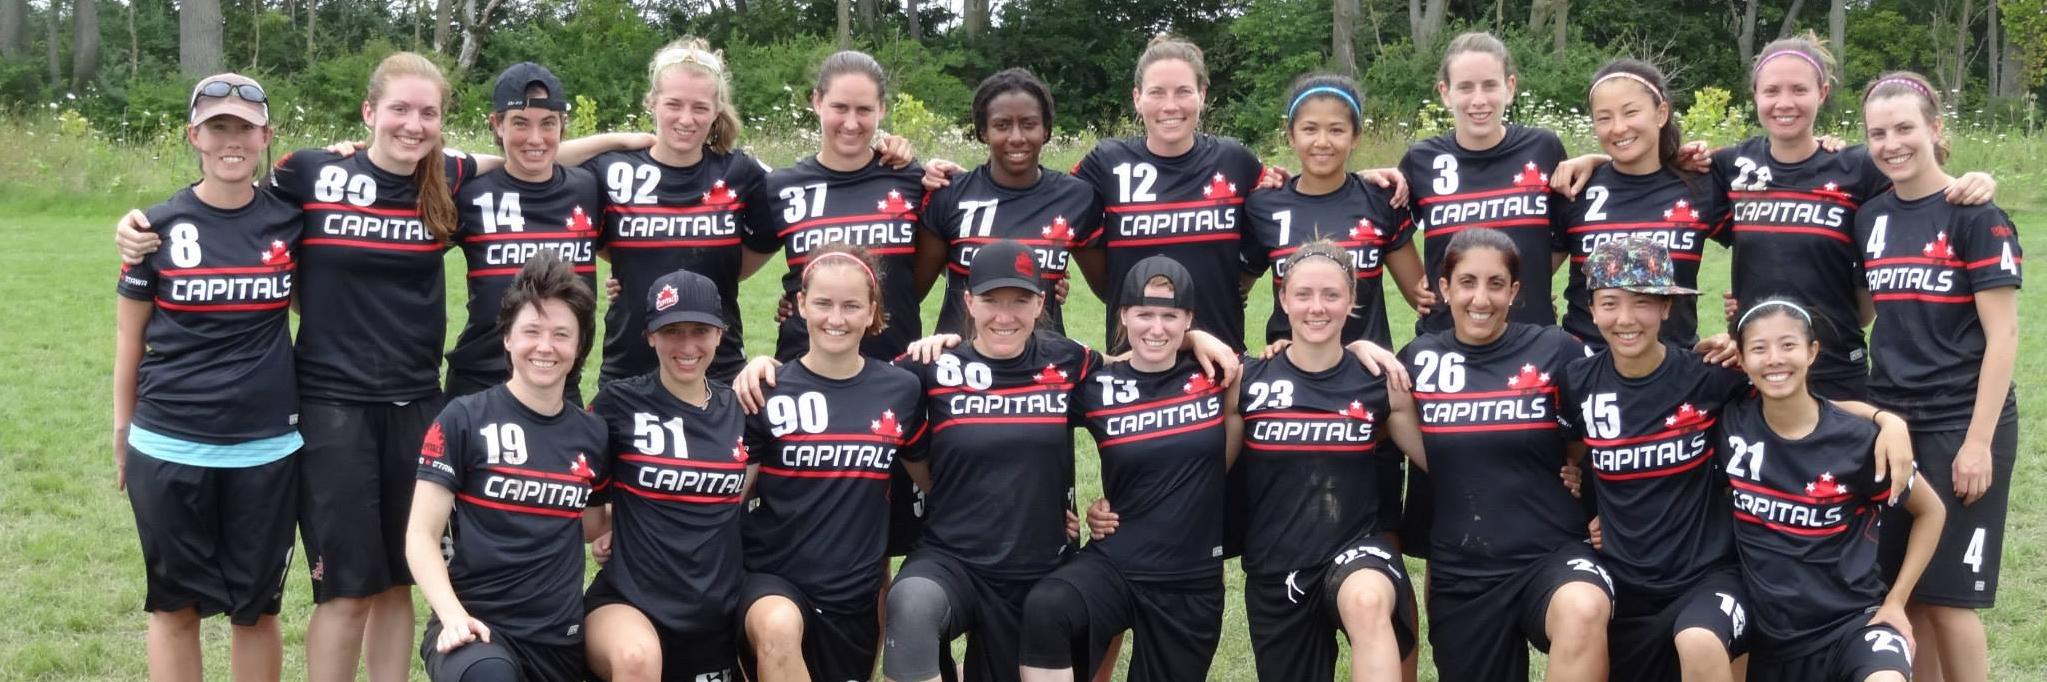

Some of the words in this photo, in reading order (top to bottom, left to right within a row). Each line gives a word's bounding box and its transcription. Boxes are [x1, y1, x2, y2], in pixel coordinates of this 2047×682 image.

[607, 161, 661, 204] 92
[1112, 162, 1158, 203] 12
[1432, 153, 1459, 195] 3
[472, 192, 525, 234] 14
[779, 182, 828, 224] 37
[958, 198, 998, 238] 77
[1120, 208, 1240, 236] CAPITALS
[1432, 195, 1548, 226] CAPITALS
[1584, 185, 1609, 222] 2
[1734, 201, 1845, 228] CAPITALS
[169, 222, 202, 268] 8
[618, 213, 736, 238] CAPITALS
[792, 222, 914, 254] CAPITALS
[1866, 214, 1889, 260] 4
[2000, 241, 2017, 275] 4
[171, 273, 292, 302] CAPITALS
[1865, 267, 1954, 293] APITALS
[935, 353, 993, 391] 80
[1414, 350, 1466, 394] 26
[766, 391, 829, 438] 90
[950, 393, 1068, 415] CAPITALS
[1246, 379, 1294, 412] 23
[1422, 397, 1547, 423] CAPITALS
[633, 412, 689, 459] 51
[1106, 396, 1220, 436] CAPITALS
[1253, 421, 1373, 442] CAPITALS
[1581, 392, 1621, 440] 15
[479, 423, 528, 465] 19
[782, 445, 897, 470] CAPITALS
[1591, 431, 1706, 471] CAPITALS
[1726, 435, 1765, 481] 21
[638, 466, 745, 494] CAPITAL
[1732, 489, 1843, 527] CAPITALS
[1963, 527, 1986, 573] 4
